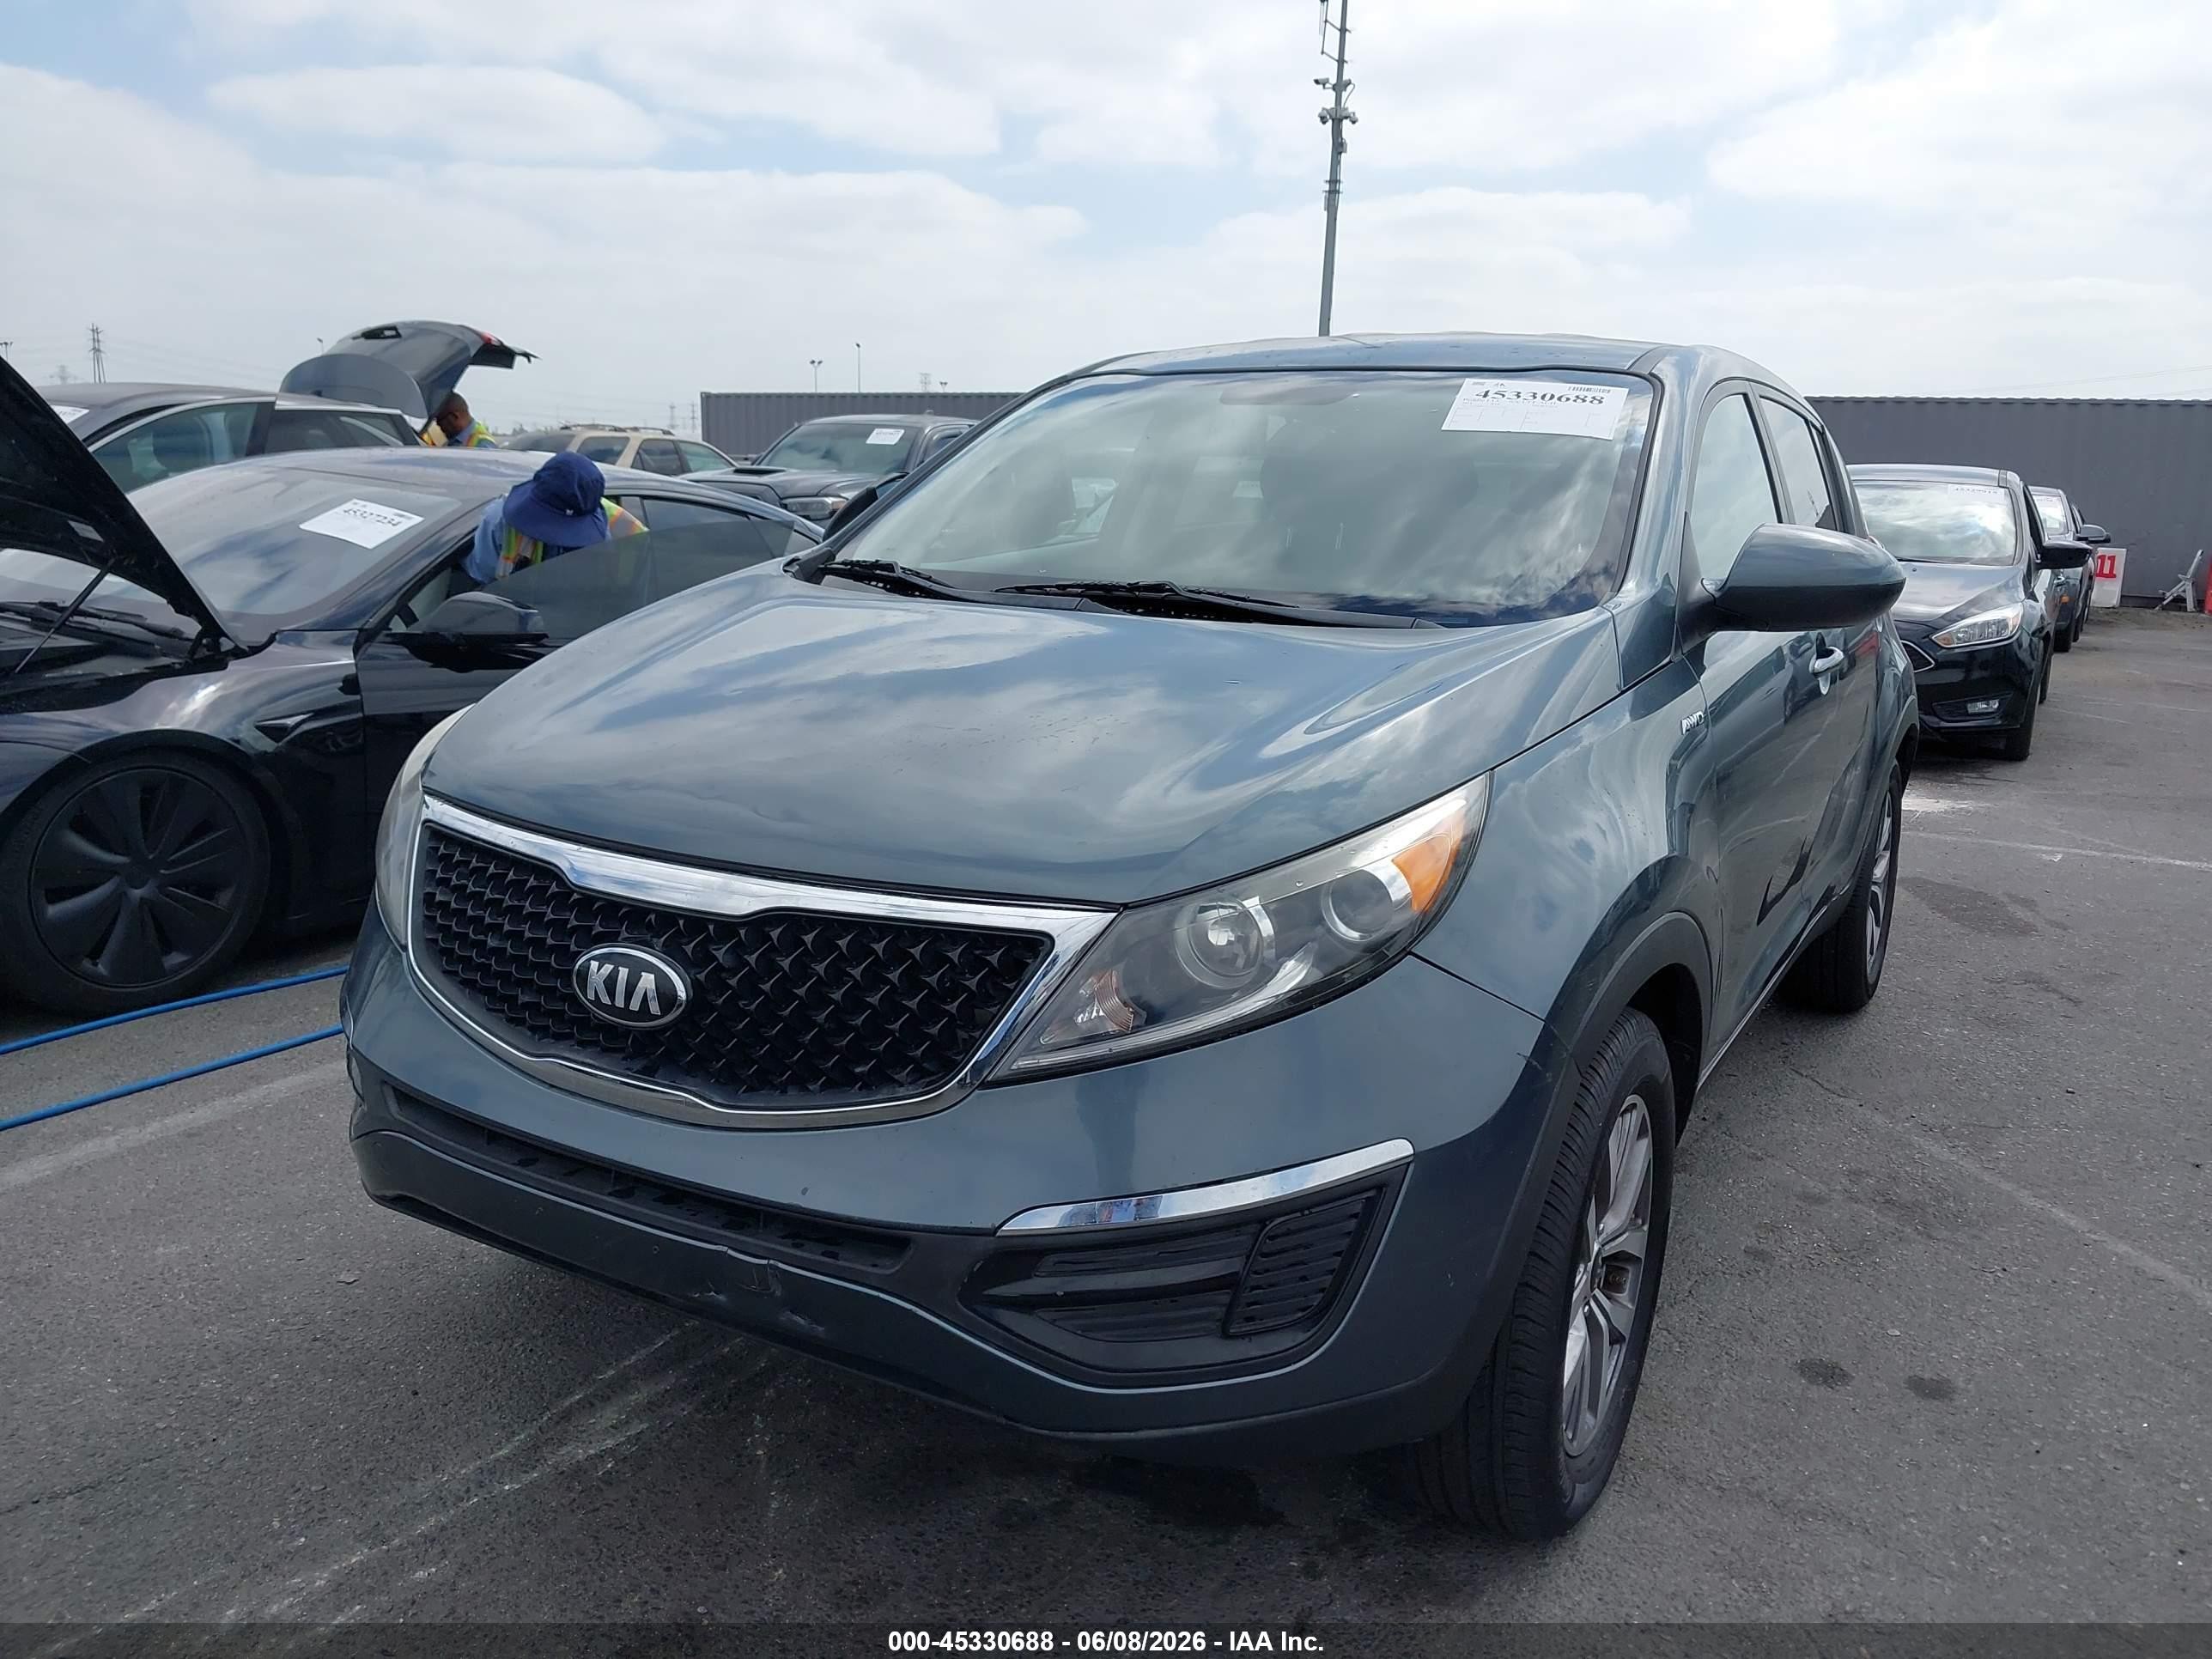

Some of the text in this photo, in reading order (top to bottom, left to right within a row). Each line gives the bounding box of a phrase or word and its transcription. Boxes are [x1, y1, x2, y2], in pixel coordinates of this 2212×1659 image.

[1475, 389, 1605, 405] 45330688
[2095, 555, 2117, 578] 11
[586, 959, 661, 1016] KIA
